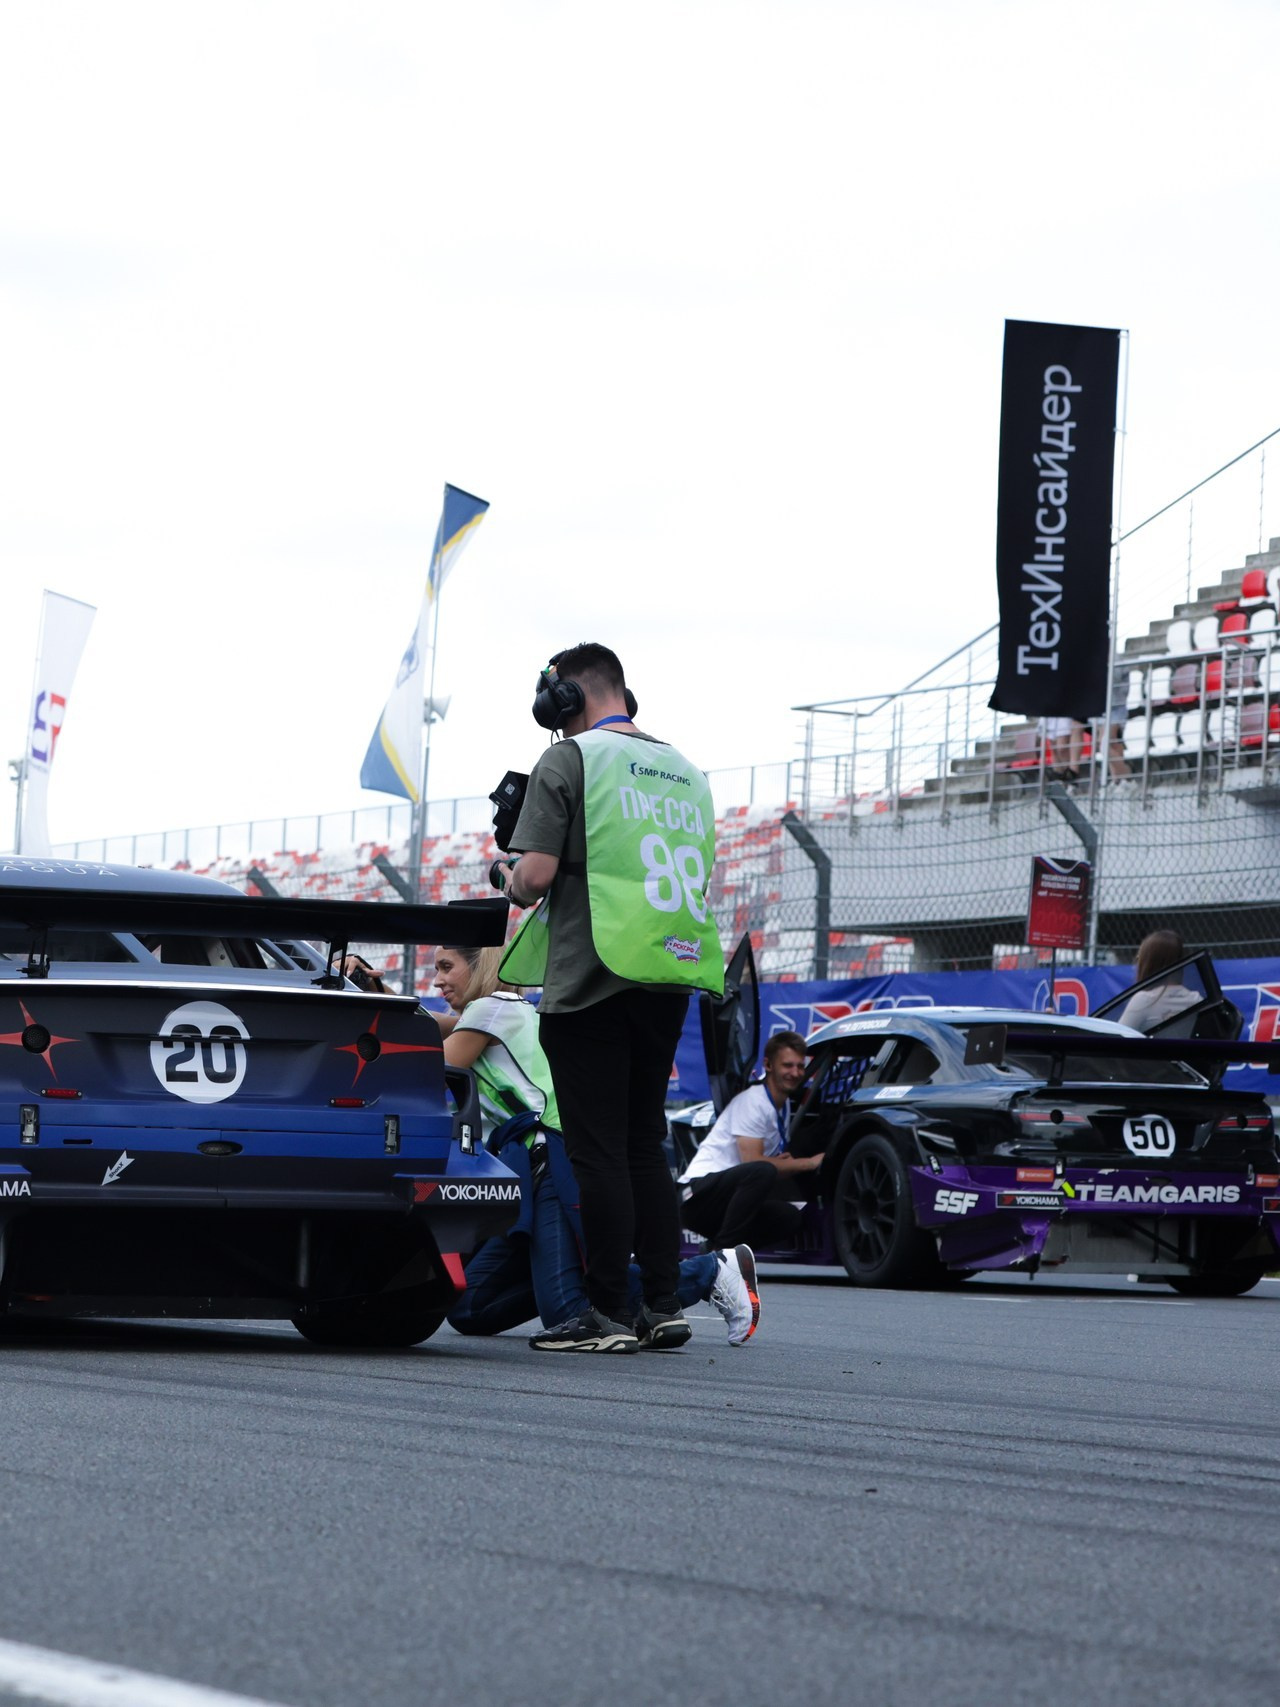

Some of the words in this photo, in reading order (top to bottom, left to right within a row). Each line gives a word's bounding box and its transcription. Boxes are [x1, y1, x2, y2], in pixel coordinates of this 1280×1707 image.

[1017, 364, 1082, 675] ТехИнсайдер
[638, 766, 659, 778] SMP
[659, 770, 692, 787] RACING
[2, 864, 120, 877] AQUA
[640, 833, 708, 924] 88
[162, 1023, 243, 1084] 20
[1129, 1119, 1171, 1151] 50
[438, 1184, 522, 1201] YOKOHAMA
[933, 1189, 980, 1215] SSF
[1014, 1195, 1060, 1206] YOKOHAMA
[1074, 1185, 1241, 1204] TEAMGARIS
